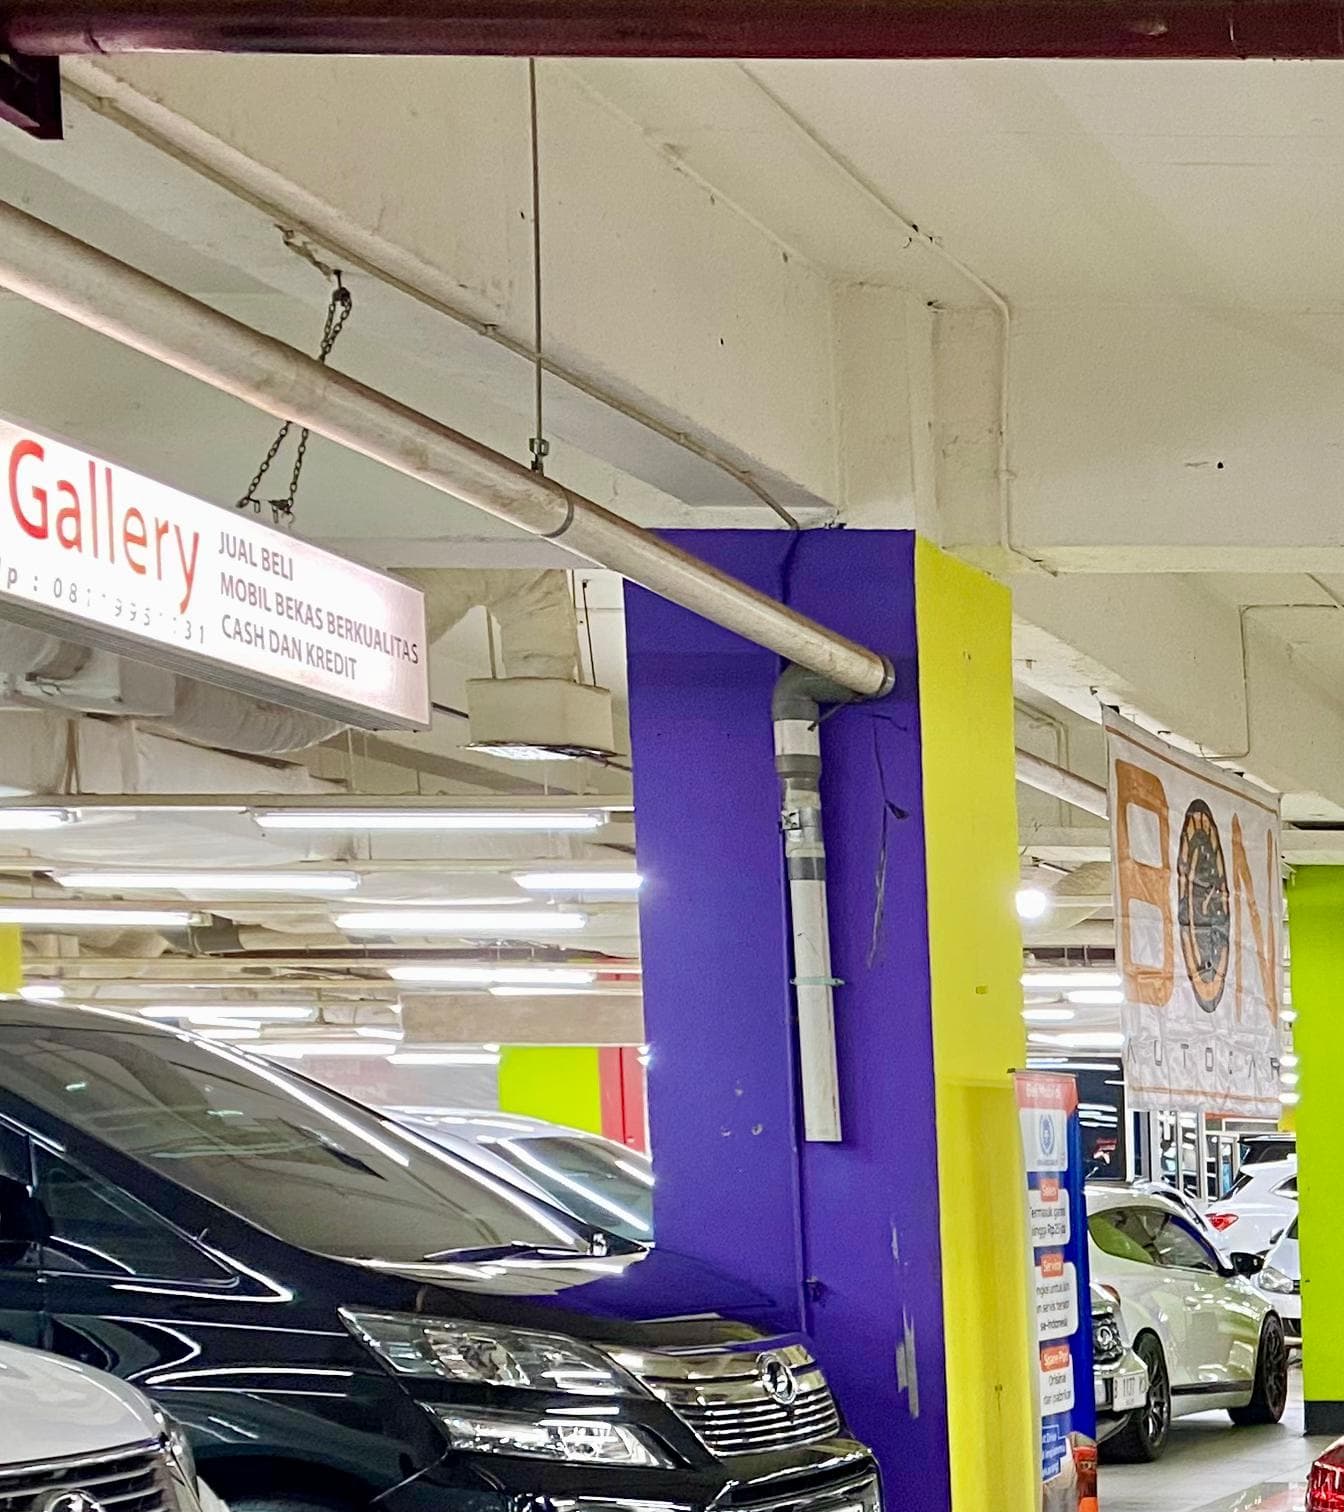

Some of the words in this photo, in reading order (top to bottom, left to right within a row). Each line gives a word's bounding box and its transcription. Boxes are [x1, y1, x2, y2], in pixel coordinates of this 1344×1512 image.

[9, 440, 199, 614] Gallery
[219, 532, 257, 567] JUAL
[262, 548, 293, 581] BELI
[220, 572, 271, 612] MOBIL
[275, 592, 323, 630] BEKAS
[327, 611, 419, 664] BERKUALITAS
[222, 614, 264, 650] CASH
[269, 629, 302, 662] DAN
[306, 642, 357, 680] KREDIT
